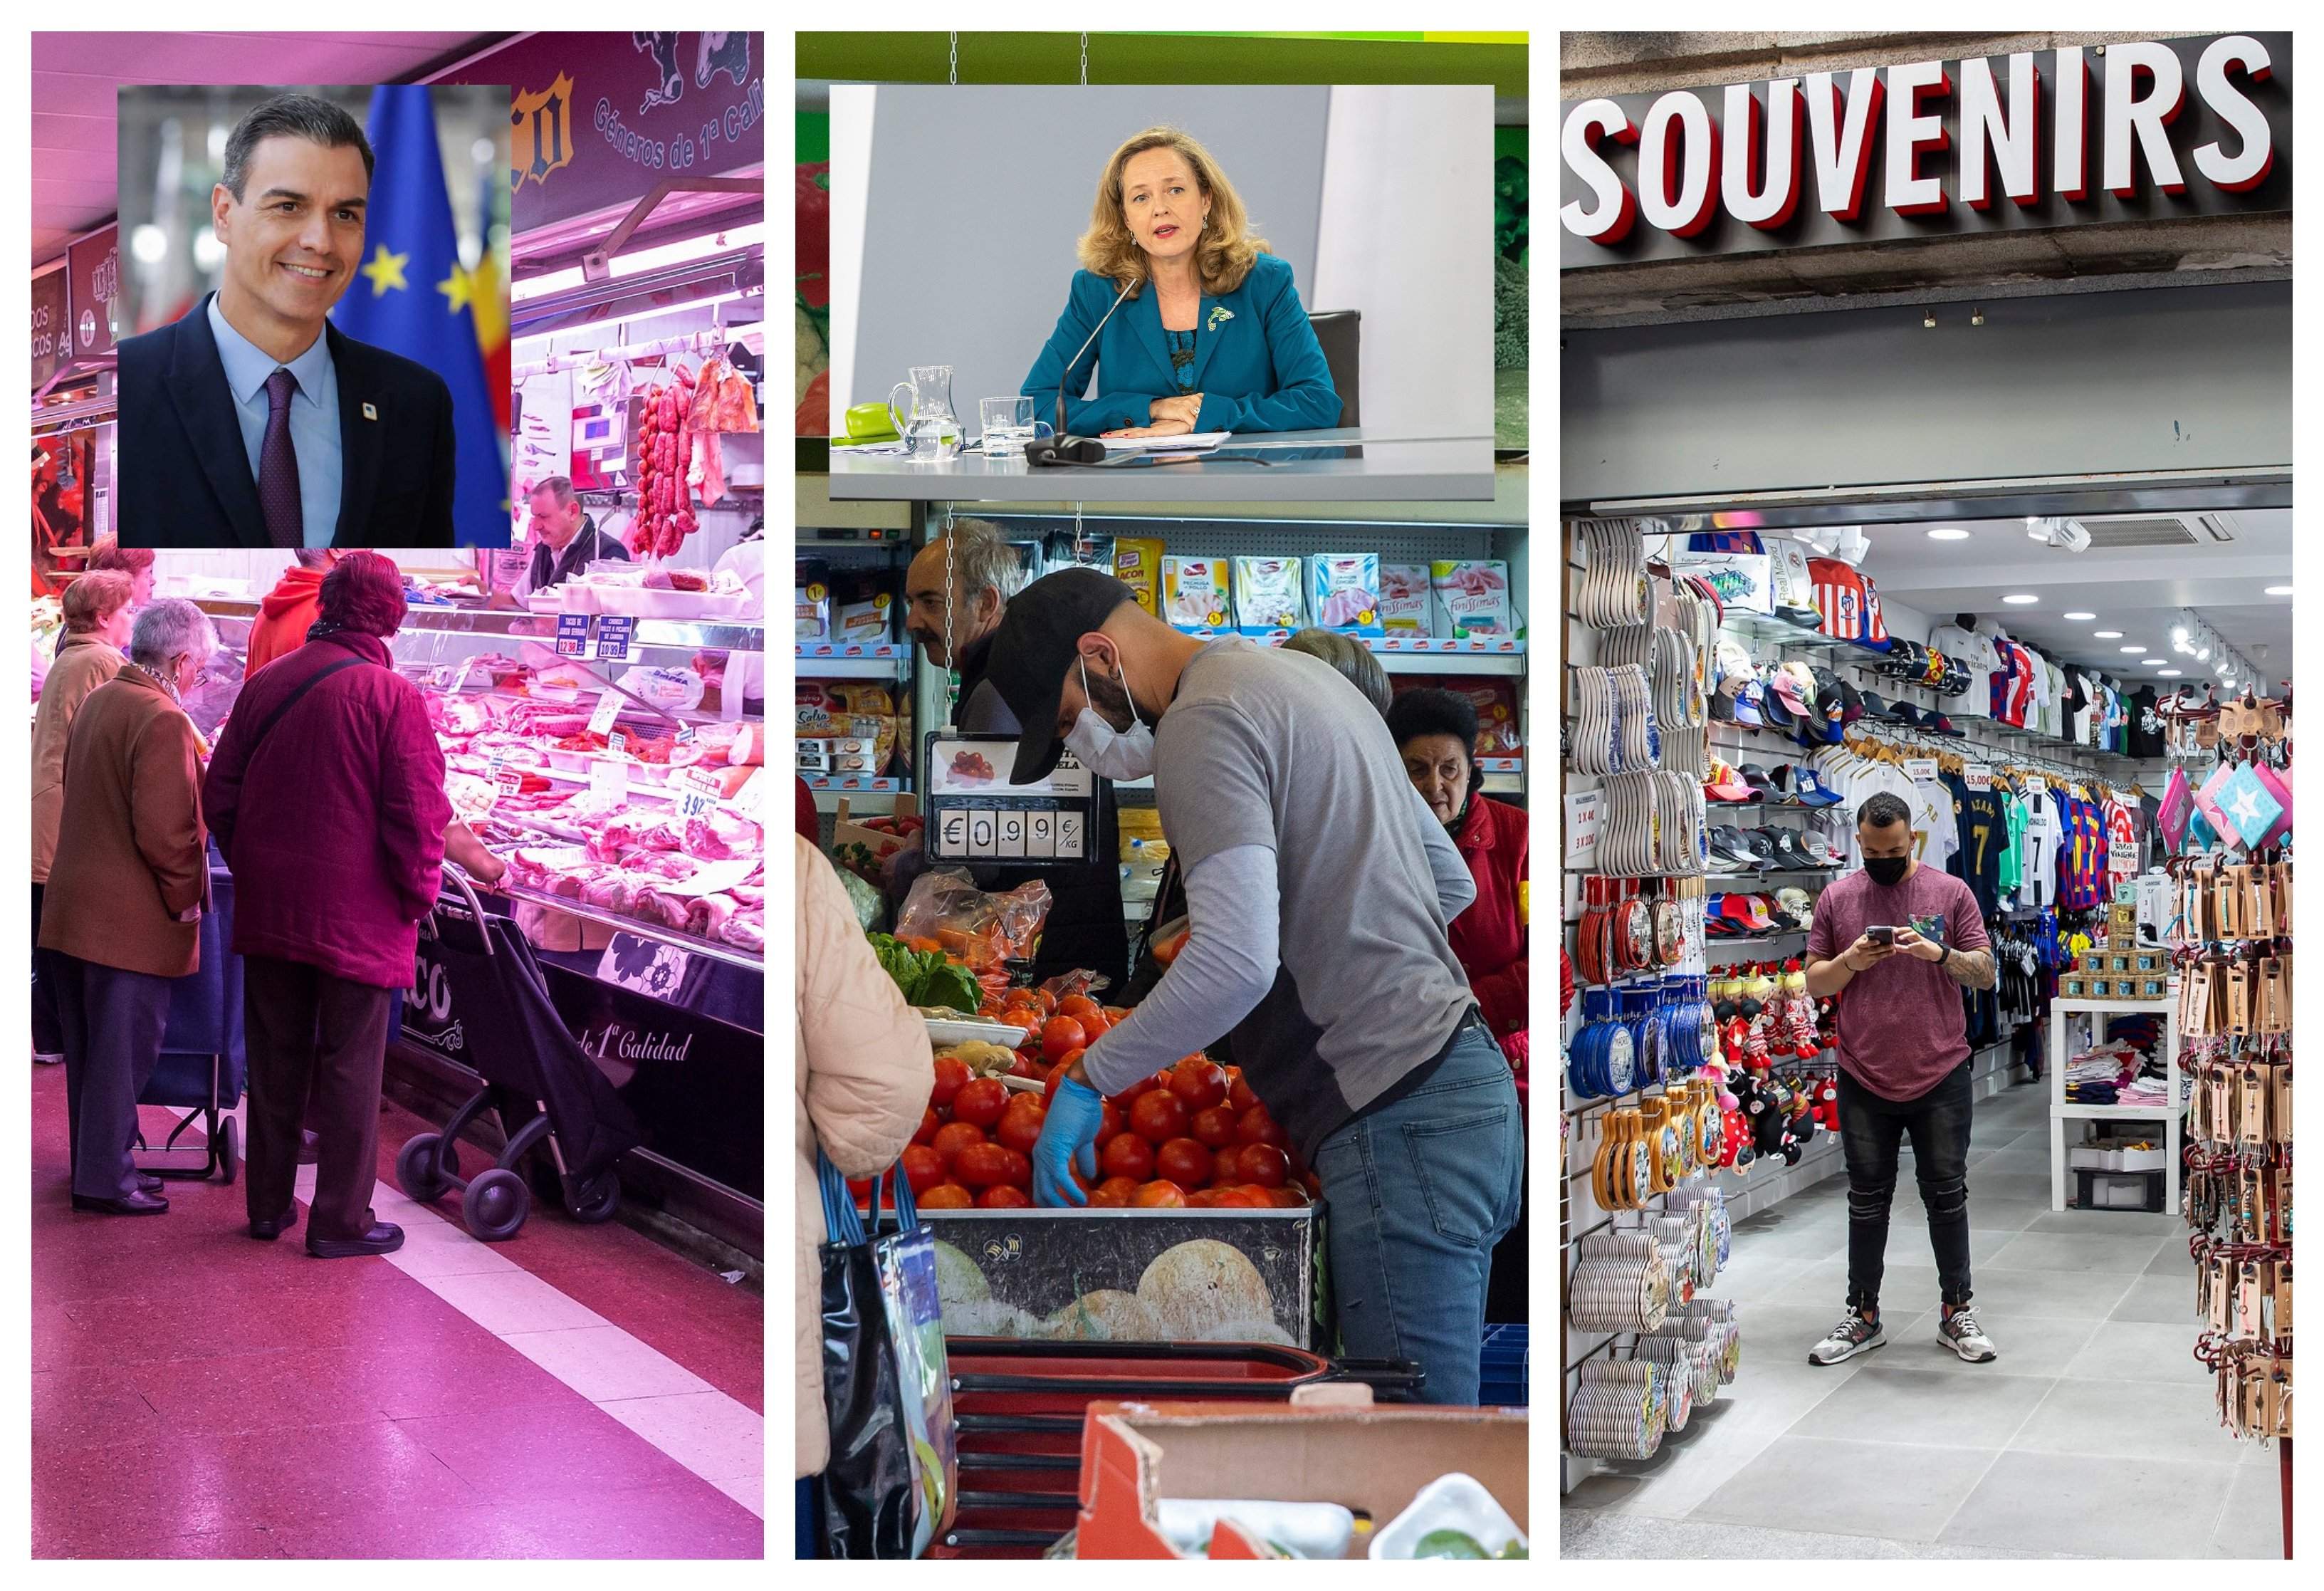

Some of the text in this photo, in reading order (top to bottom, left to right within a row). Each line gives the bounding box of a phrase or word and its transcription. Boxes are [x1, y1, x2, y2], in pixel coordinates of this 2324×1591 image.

[594, 97, 664, 169] Géneros
[670, 133, 693, 169] de
[1560, 35, 2273, 244] SOUVENIRS
[1769, 545, 1789, 600] Real Madrid
[797, 709, 829, 725] Salsa
[1056, 761, 1080, 769] ELA
[1966, 774, 1991, 786] 15,00€
[1973, 825, 1990, 875] 7
[2032, 836, 2042, 873] 7
[577, 1029, 593, 1055] de
[618, 1030, 693, 1061] Calidad
